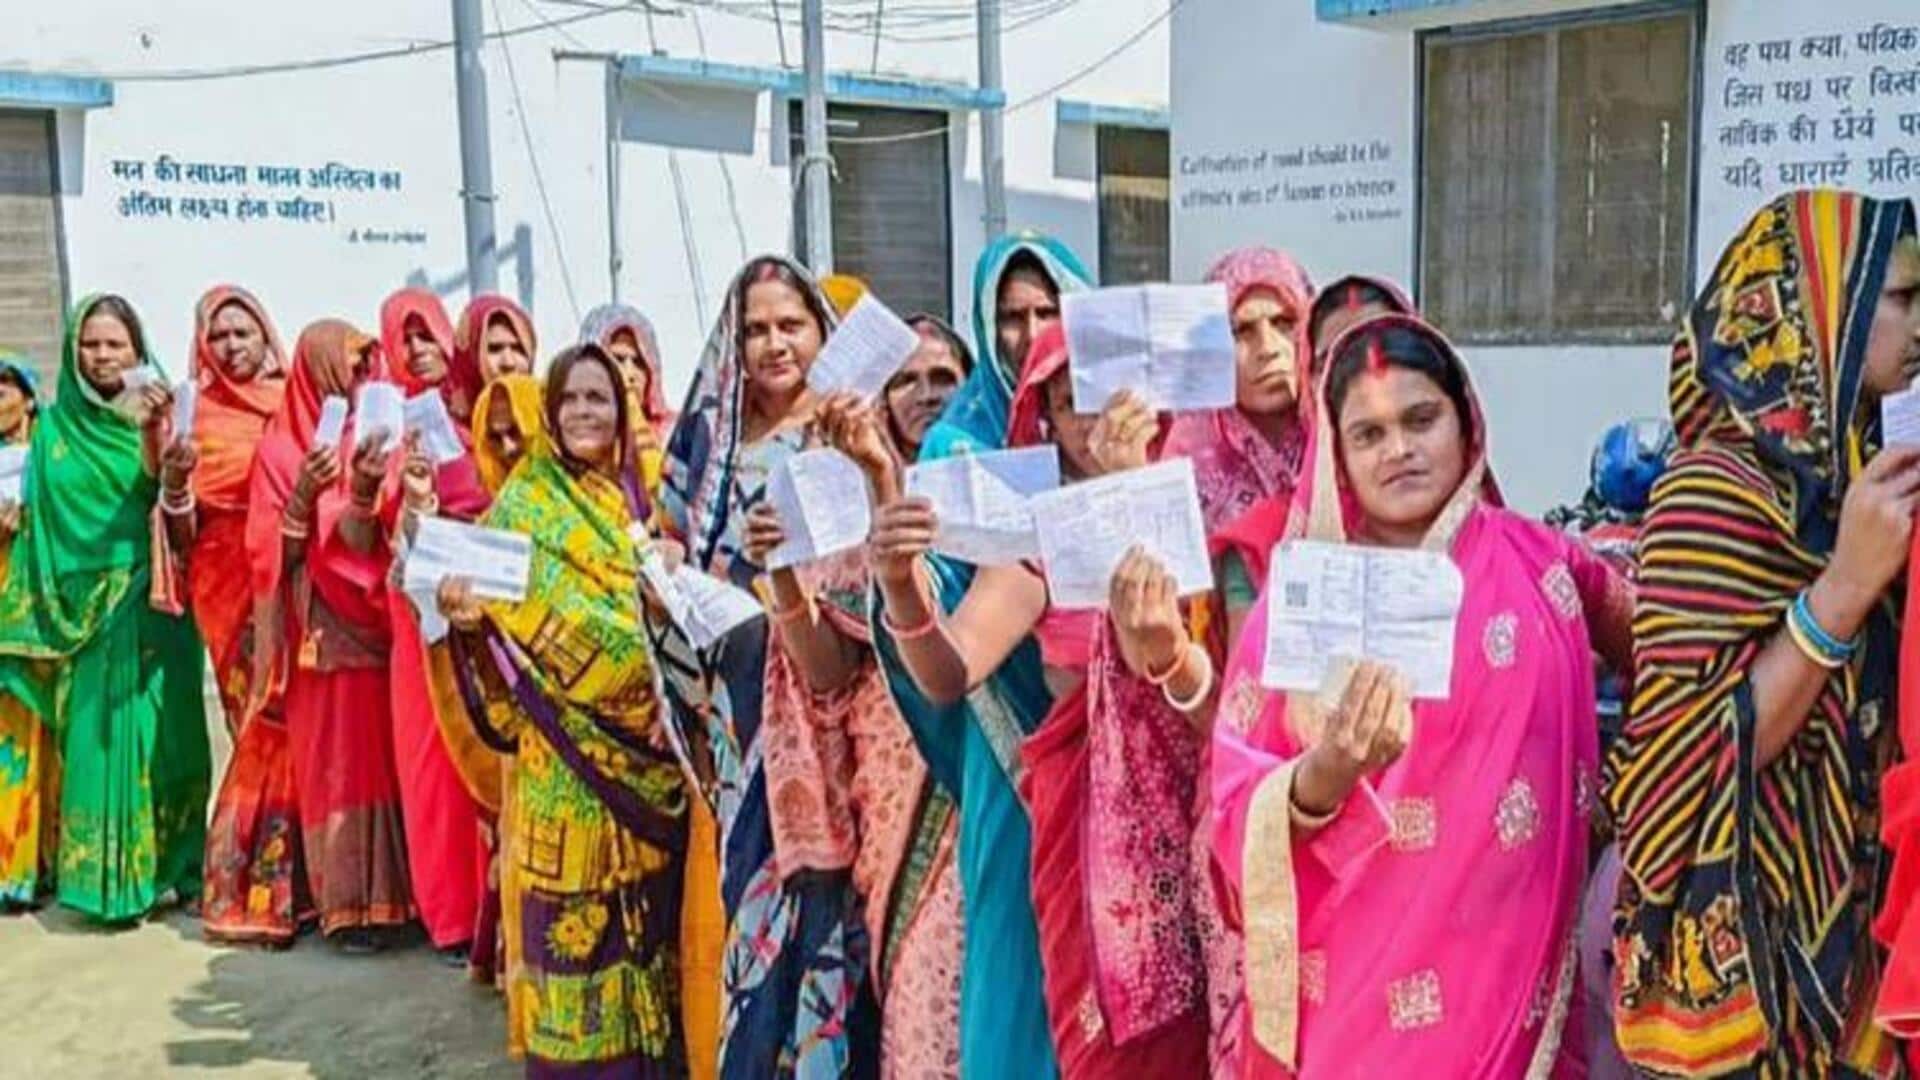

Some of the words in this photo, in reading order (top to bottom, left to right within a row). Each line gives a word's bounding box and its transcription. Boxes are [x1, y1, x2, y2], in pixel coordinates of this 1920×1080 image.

[1758, 40, 1791, 62] पथ
[1826, 75, 1853, 99] पर
[1789, 113, 1818, 142] की
[112, 160, 144, 180] मन
[154, 154, 181, 183] की
[1723, 156, 1762, 188] यदि
[118, 190, 172, 218] अंतिम
